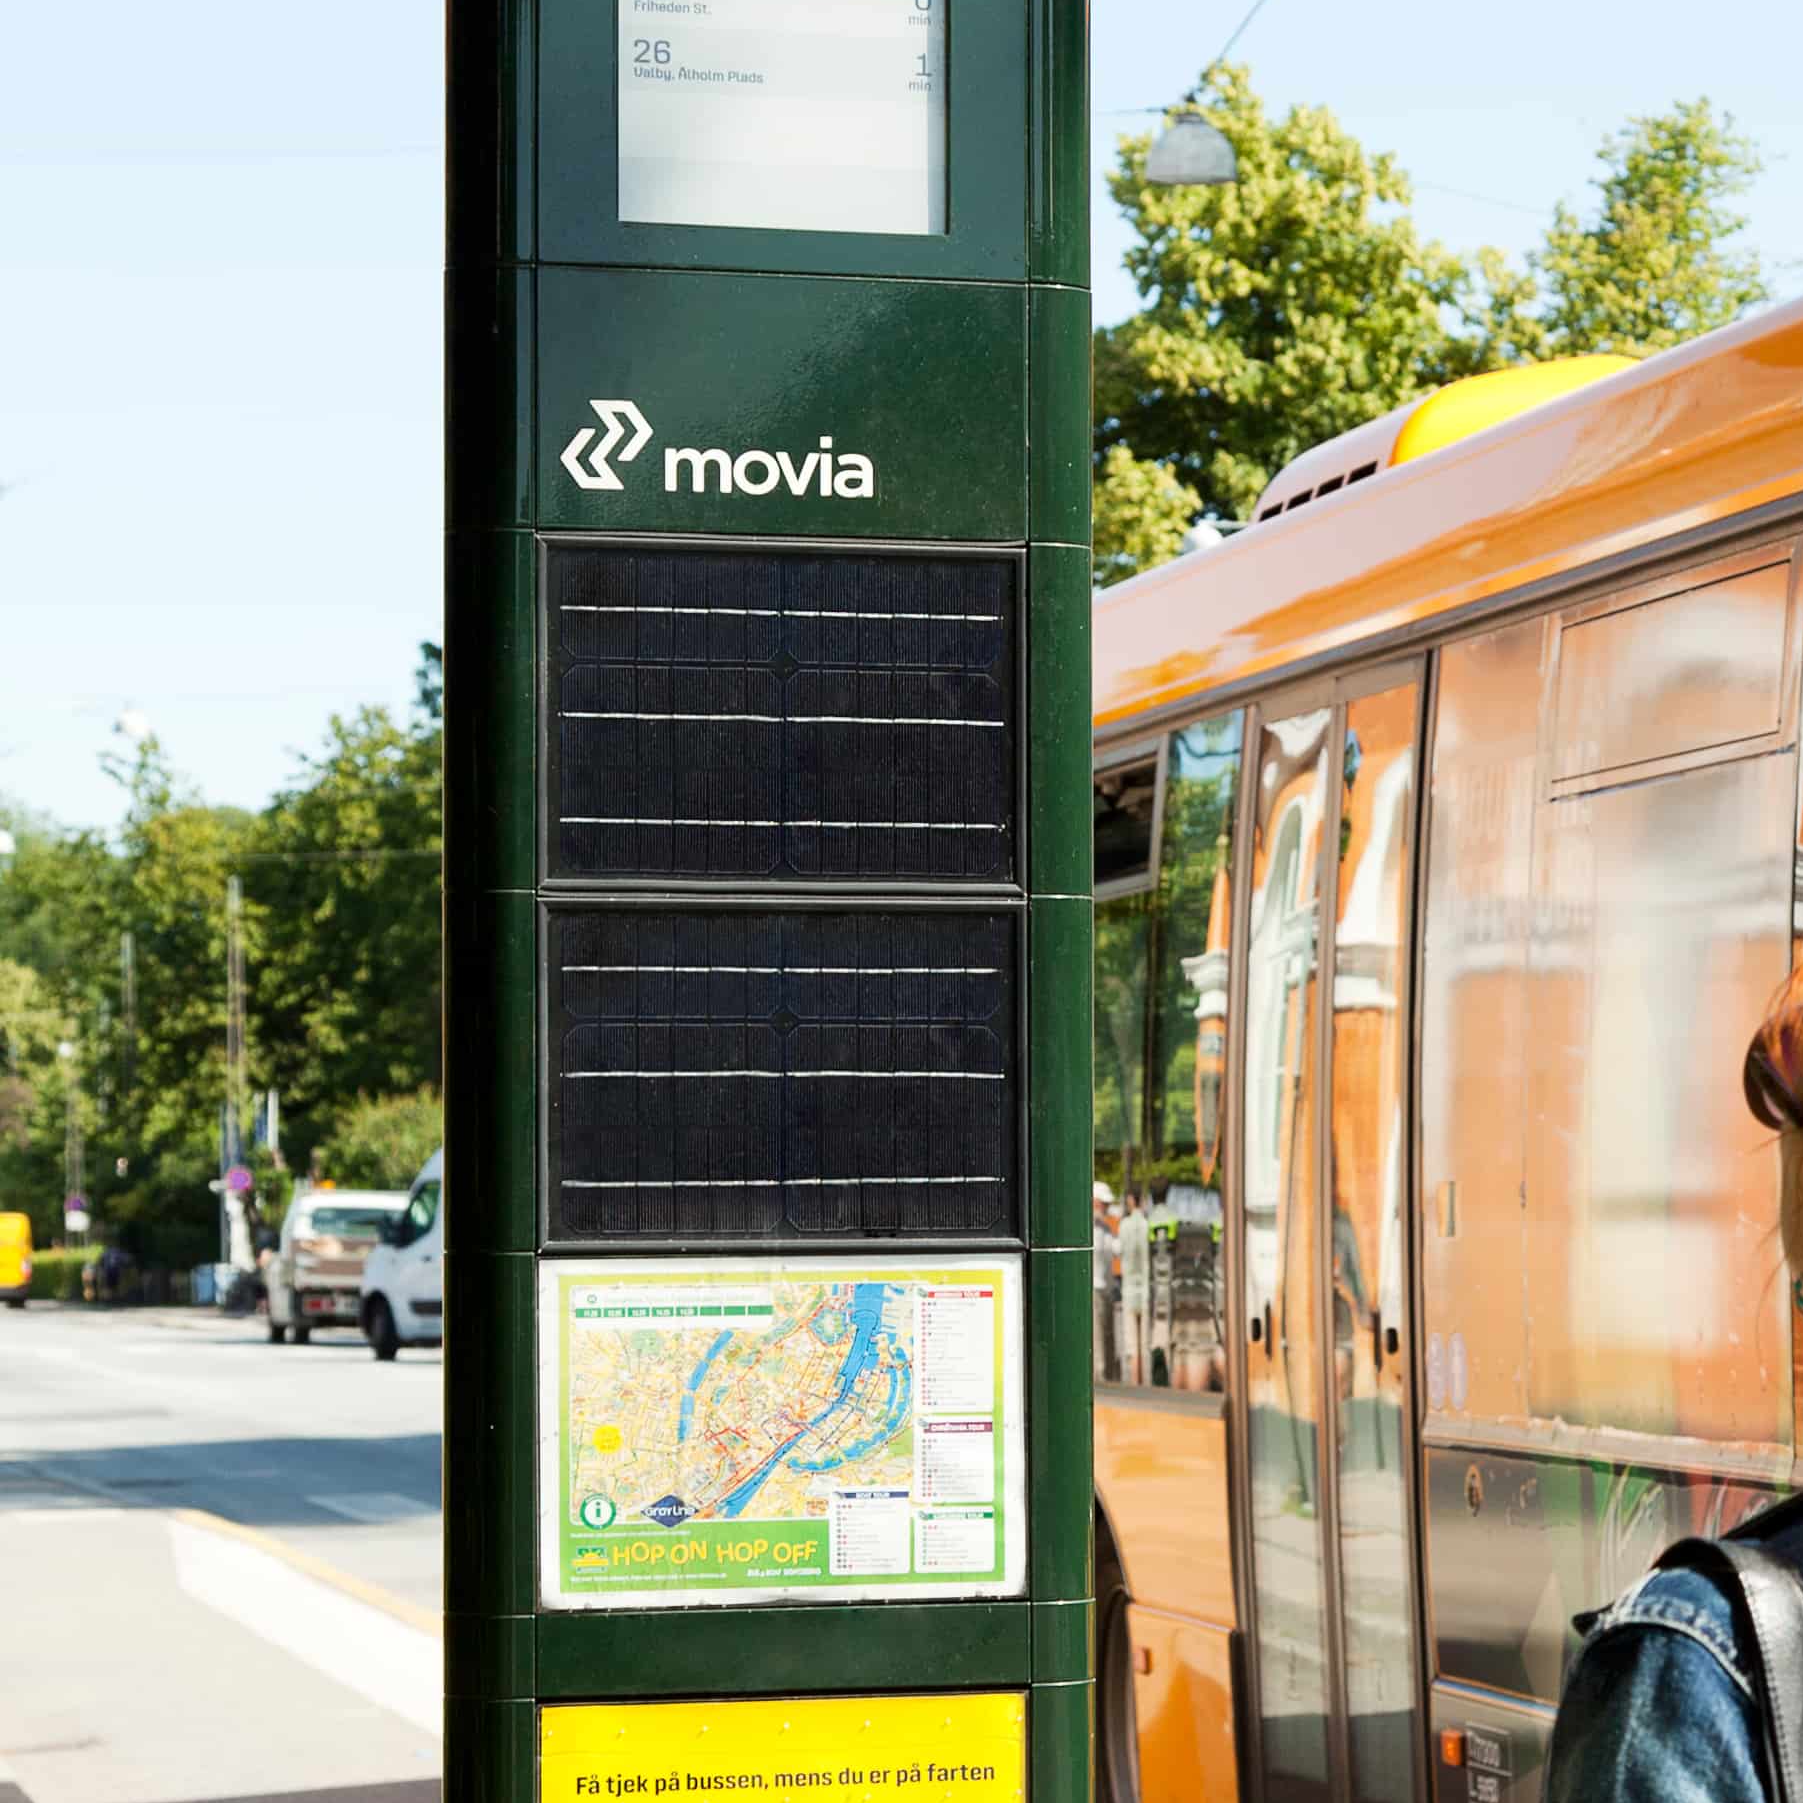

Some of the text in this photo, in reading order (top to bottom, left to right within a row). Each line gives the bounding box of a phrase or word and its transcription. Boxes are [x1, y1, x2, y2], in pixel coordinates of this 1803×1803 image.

[633, 39, 933, 77] 26 1
[665, 436, 873, 497] movia
[612, 1538, 819, 1566] HOP ON HOP OFF
[576, 1763, 996, 1797] Få tjek på bussen, mens du er på farten
